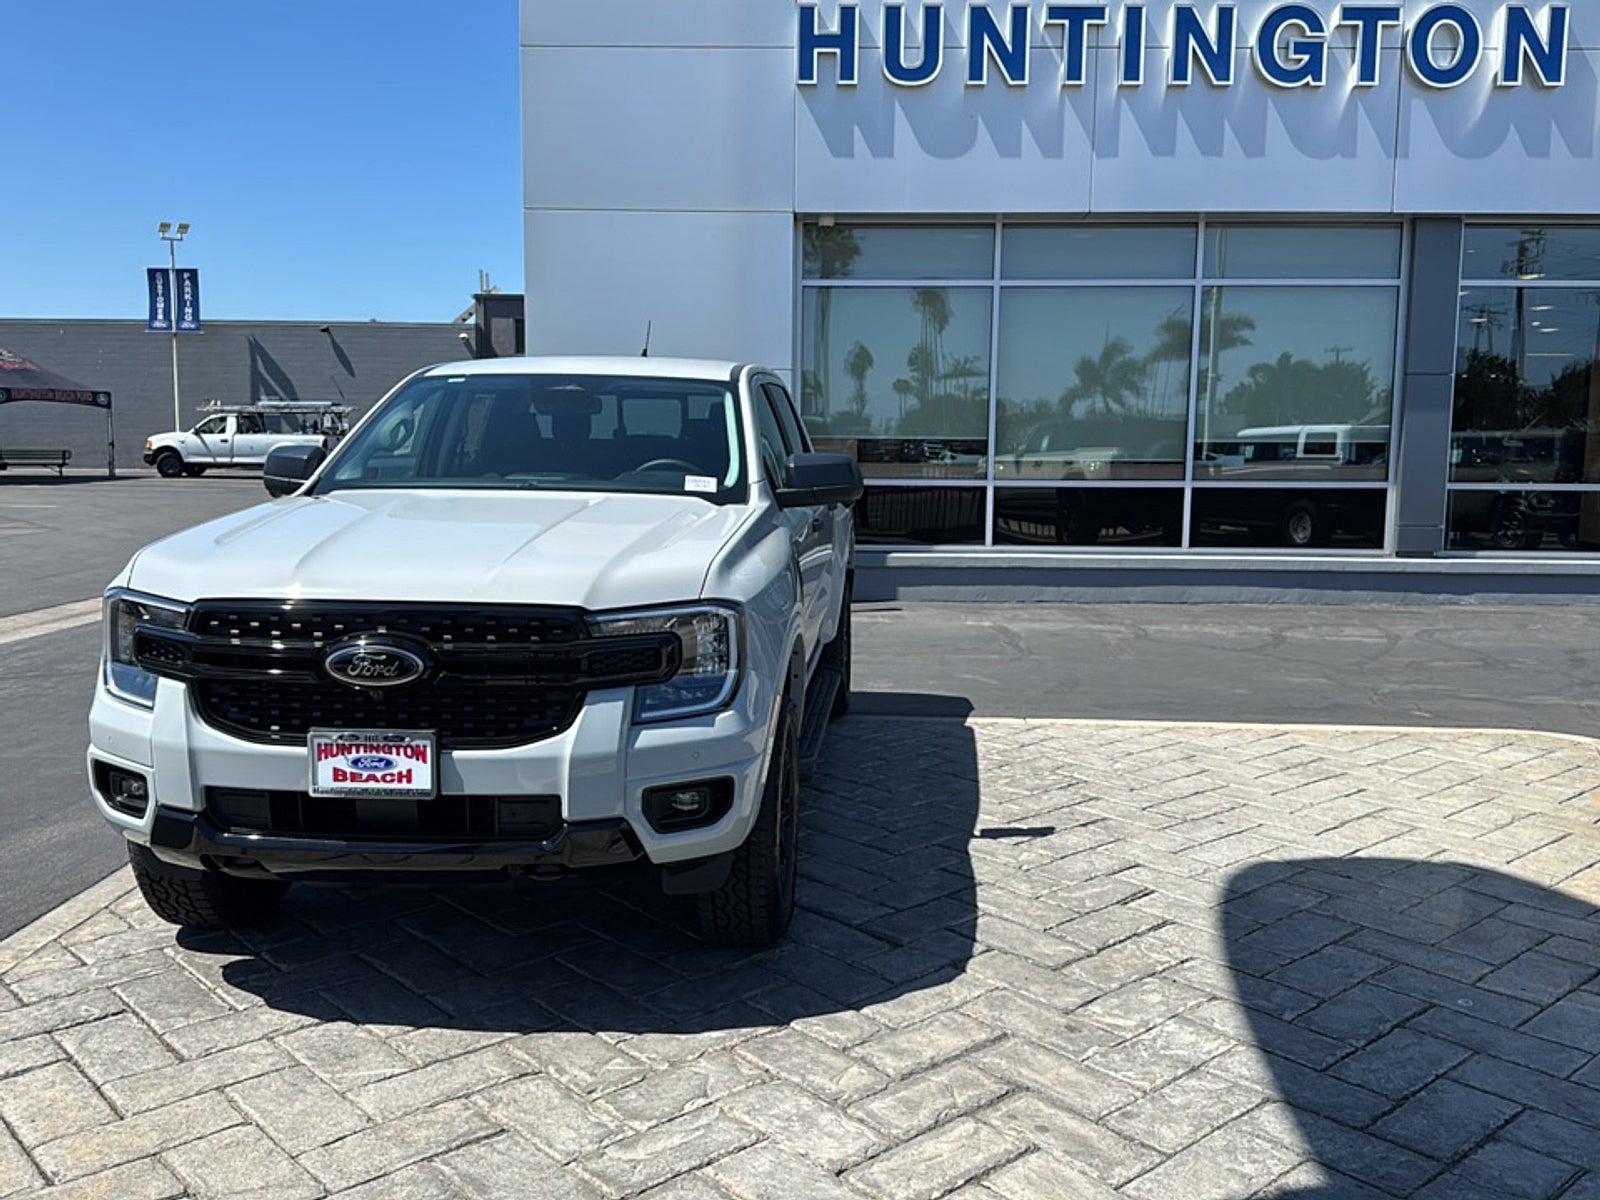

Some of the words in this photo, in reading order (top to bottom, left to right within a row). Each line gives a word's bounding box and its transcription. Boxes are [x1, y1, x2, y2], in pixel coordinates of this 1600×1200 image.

[797, 2, 1568, 88] HUNTINGTON
[183, 272, 193, 321] PARKING
[347, 653, 399, 676] Ford
[316, 742, 428, 765] HUNTINGTON
[357, 756, 387, 769] Ford
[332, 766, 413, 785] BEACH
